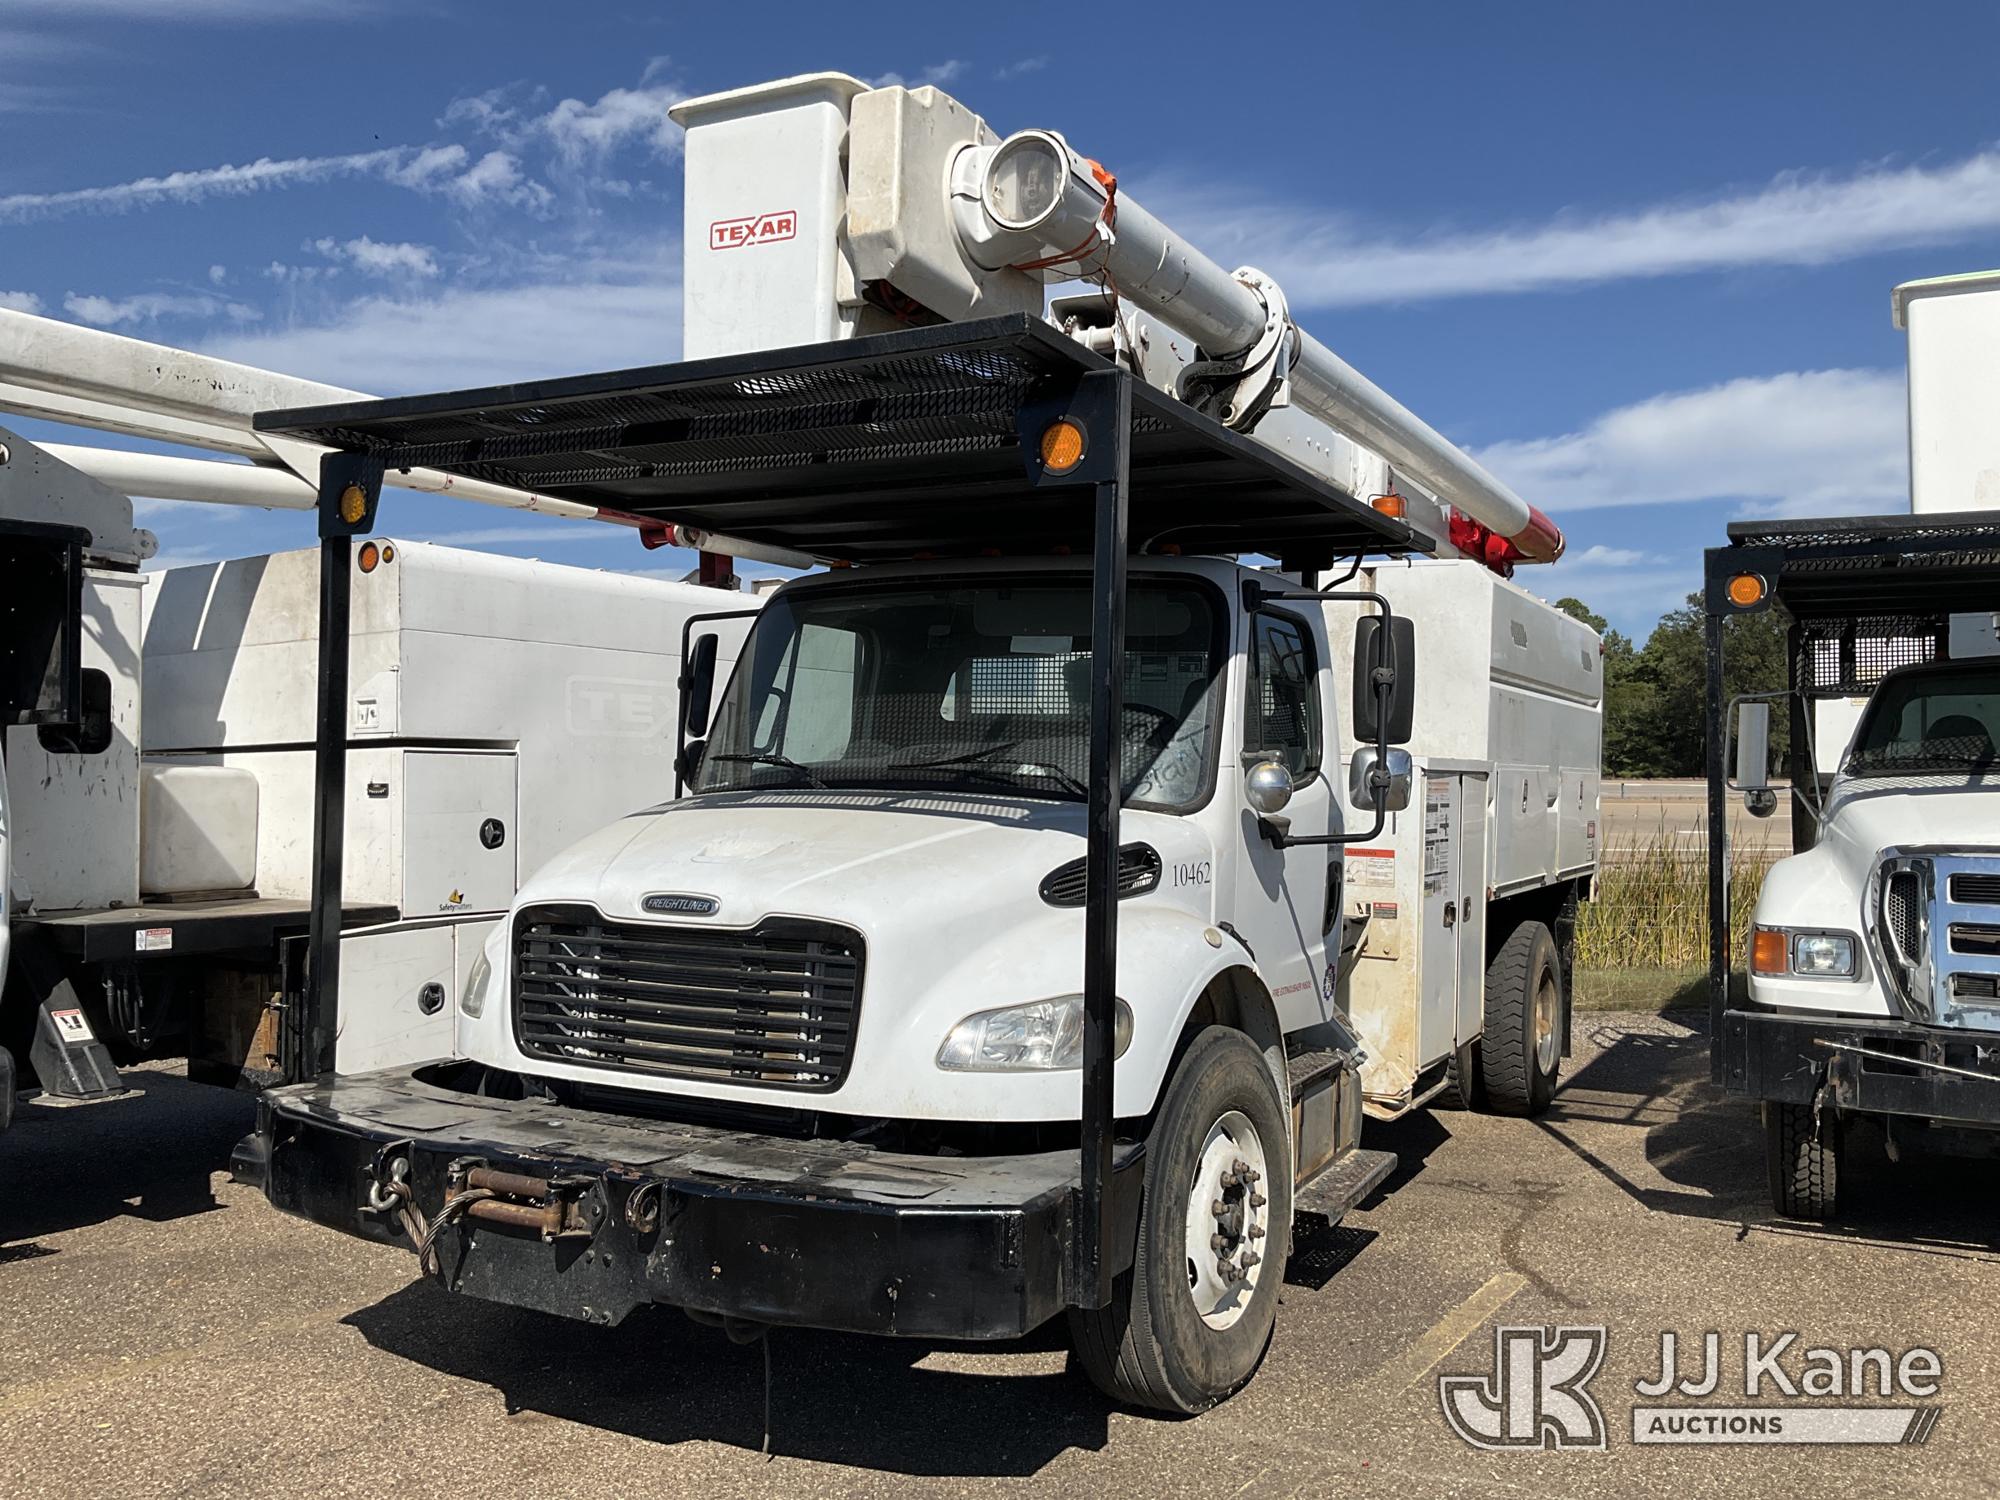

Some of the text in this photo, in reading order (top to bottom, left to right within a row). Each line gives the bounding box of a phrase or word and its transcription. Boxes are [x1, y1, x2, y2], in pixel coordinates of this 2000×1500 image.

[714, 217, 792, 243] TEXAR
[1173, 861, 1211, 887] 10462
[647, 897, 711, 911] FREIGHTLINER
